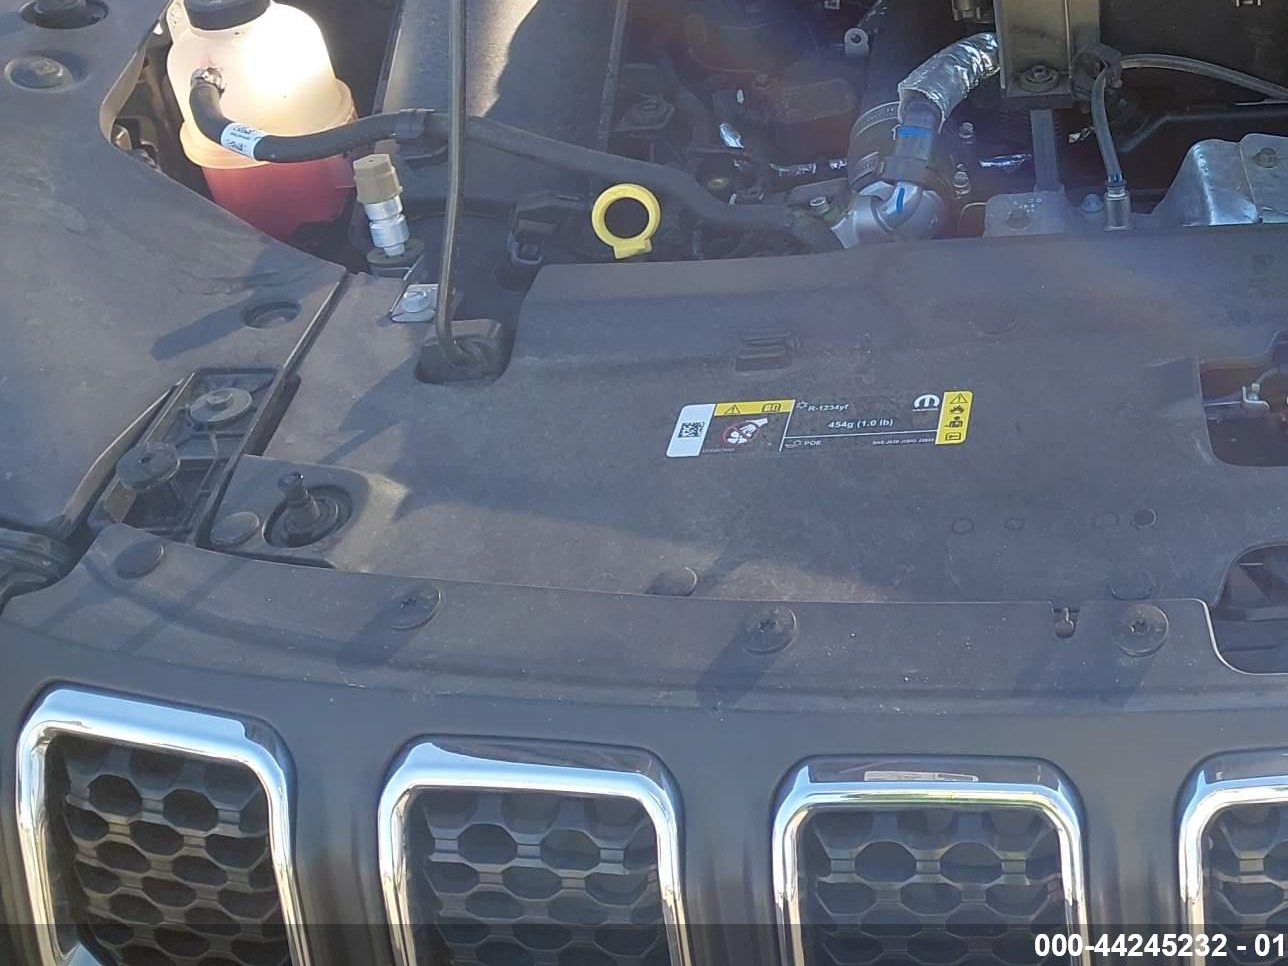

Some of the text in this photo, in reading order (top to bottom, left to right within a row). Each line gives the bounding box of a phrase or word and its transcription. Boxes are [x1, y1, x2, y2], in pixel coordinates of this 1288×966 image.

[807, 403, 849, 412] R-1234yf
[828, 418, 894, 429] 454g (1.0 lb)
